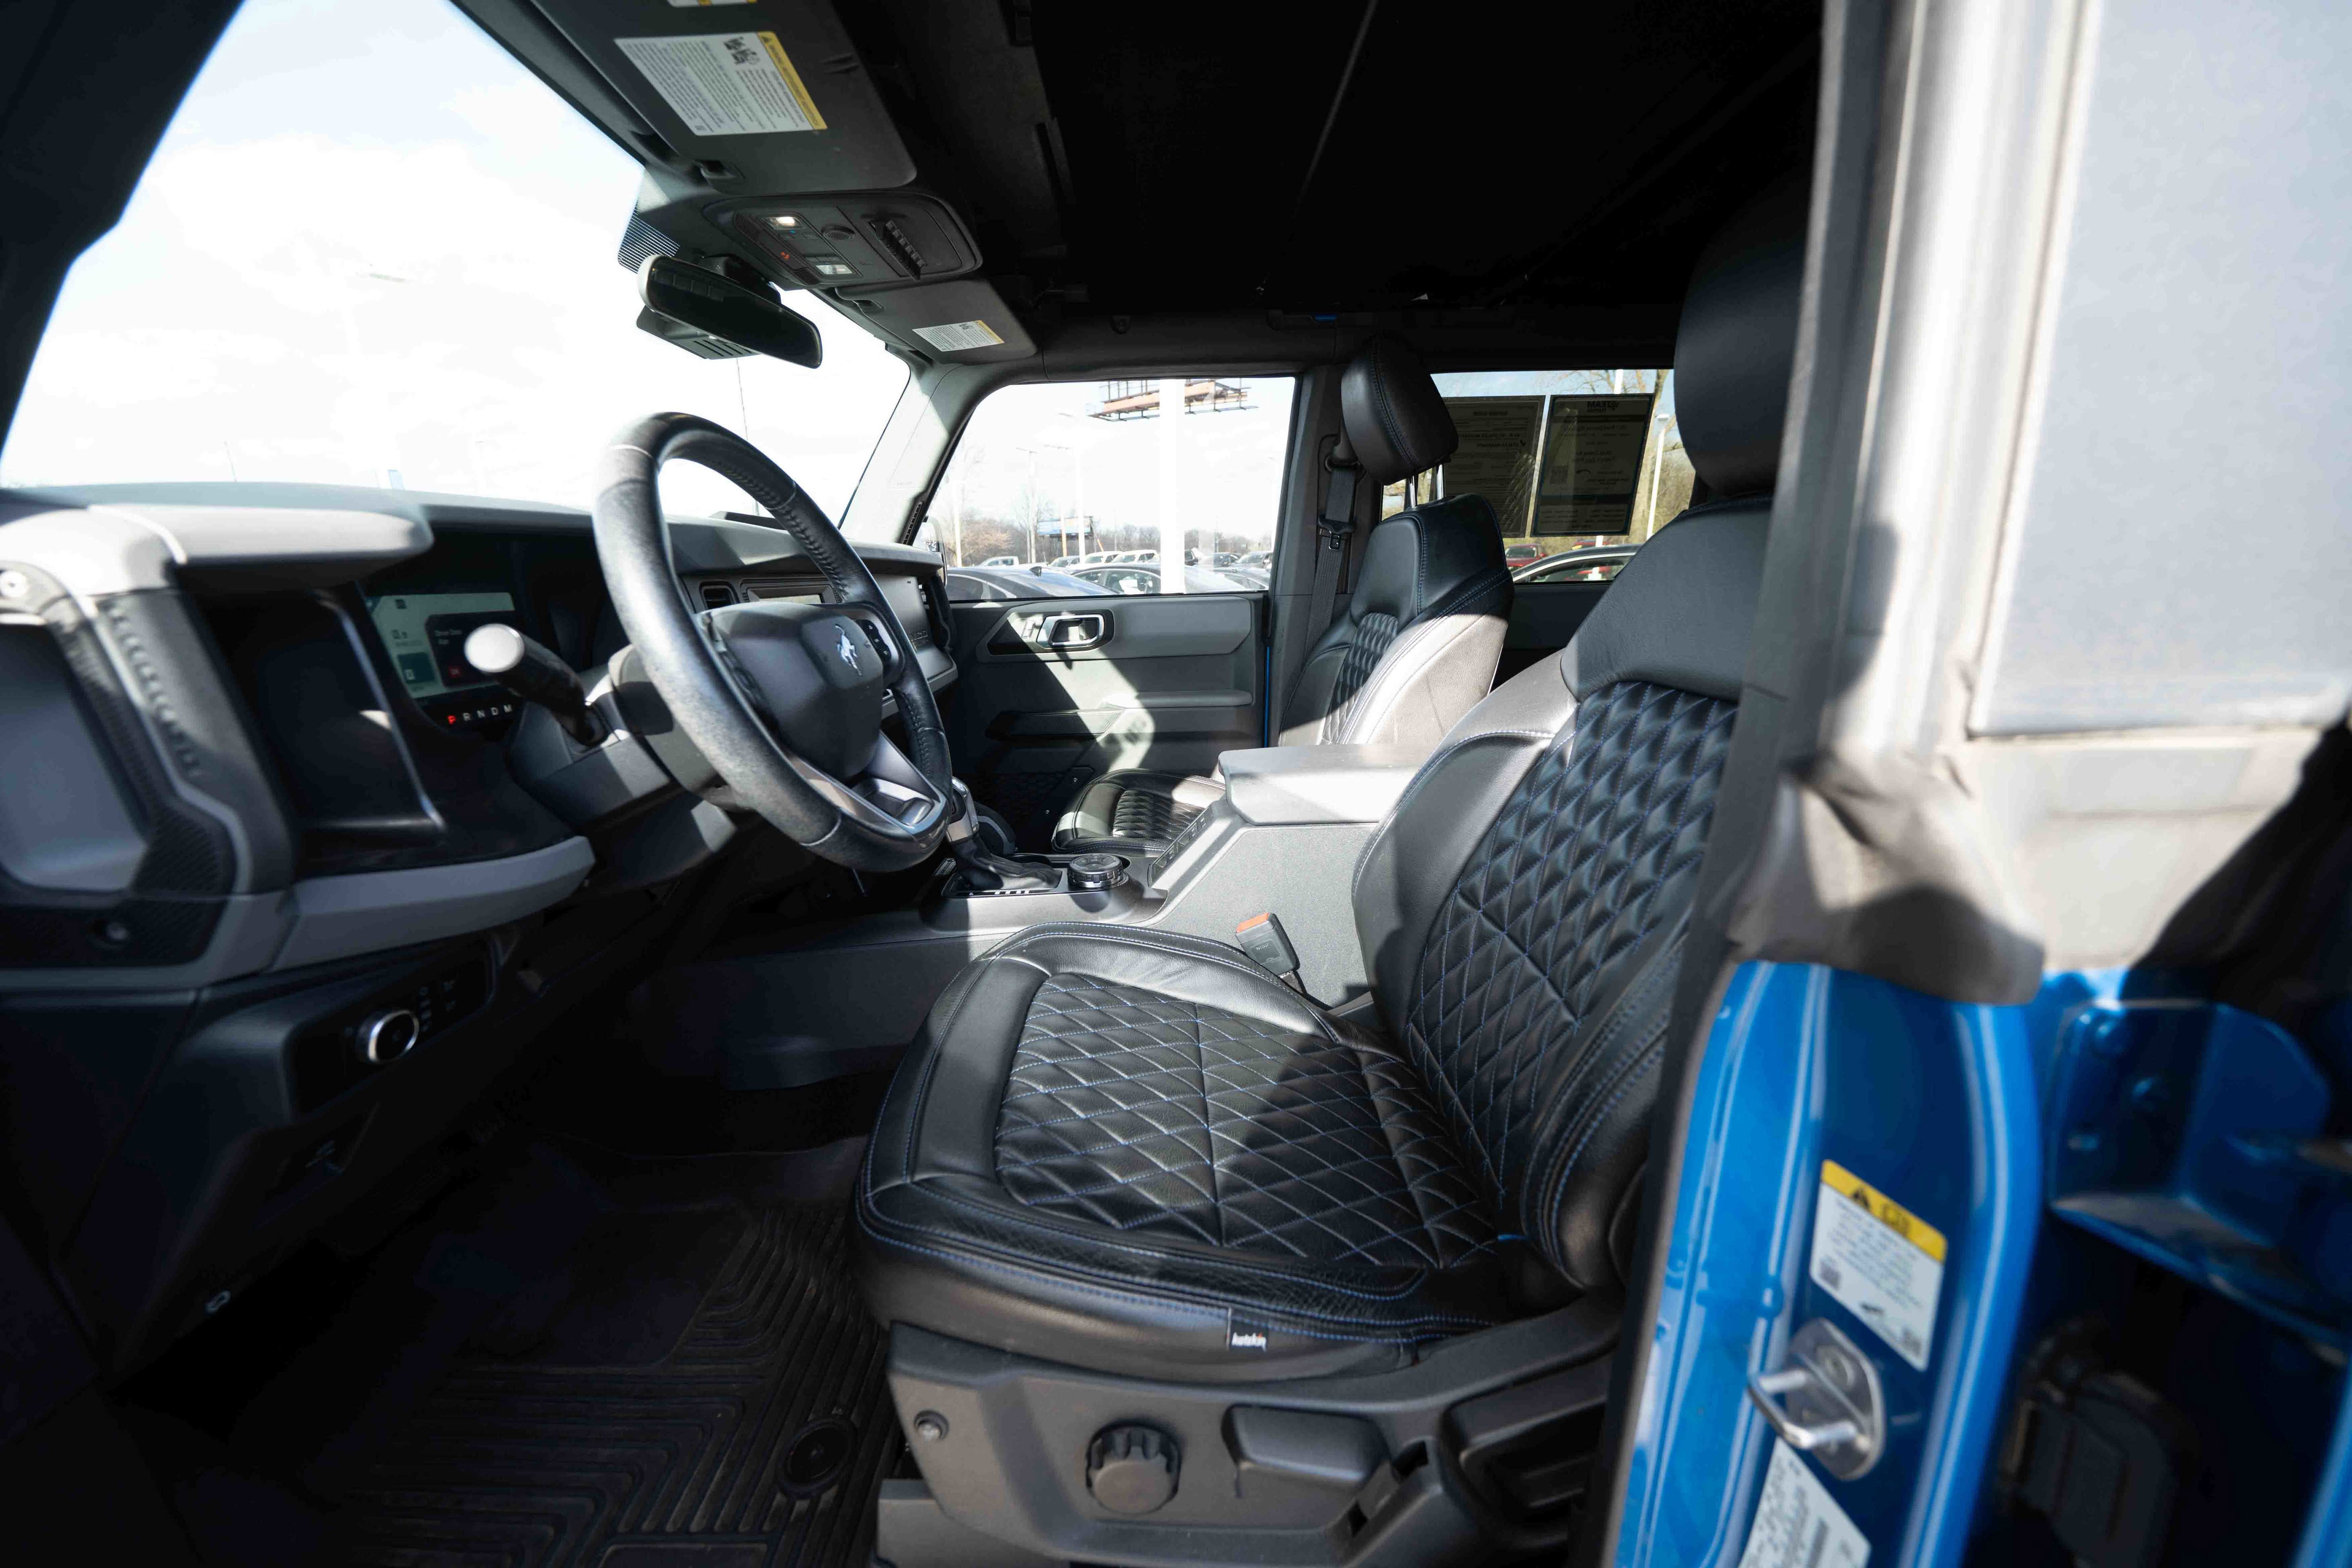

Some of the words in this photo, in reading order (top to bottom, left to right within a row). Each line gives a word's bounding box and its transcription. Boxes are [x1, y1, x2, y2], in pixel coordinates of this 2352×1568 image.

[448, 715, 456, 724] P
[477, 710, 485, 718] N
[503, 704, 512, 713] M
